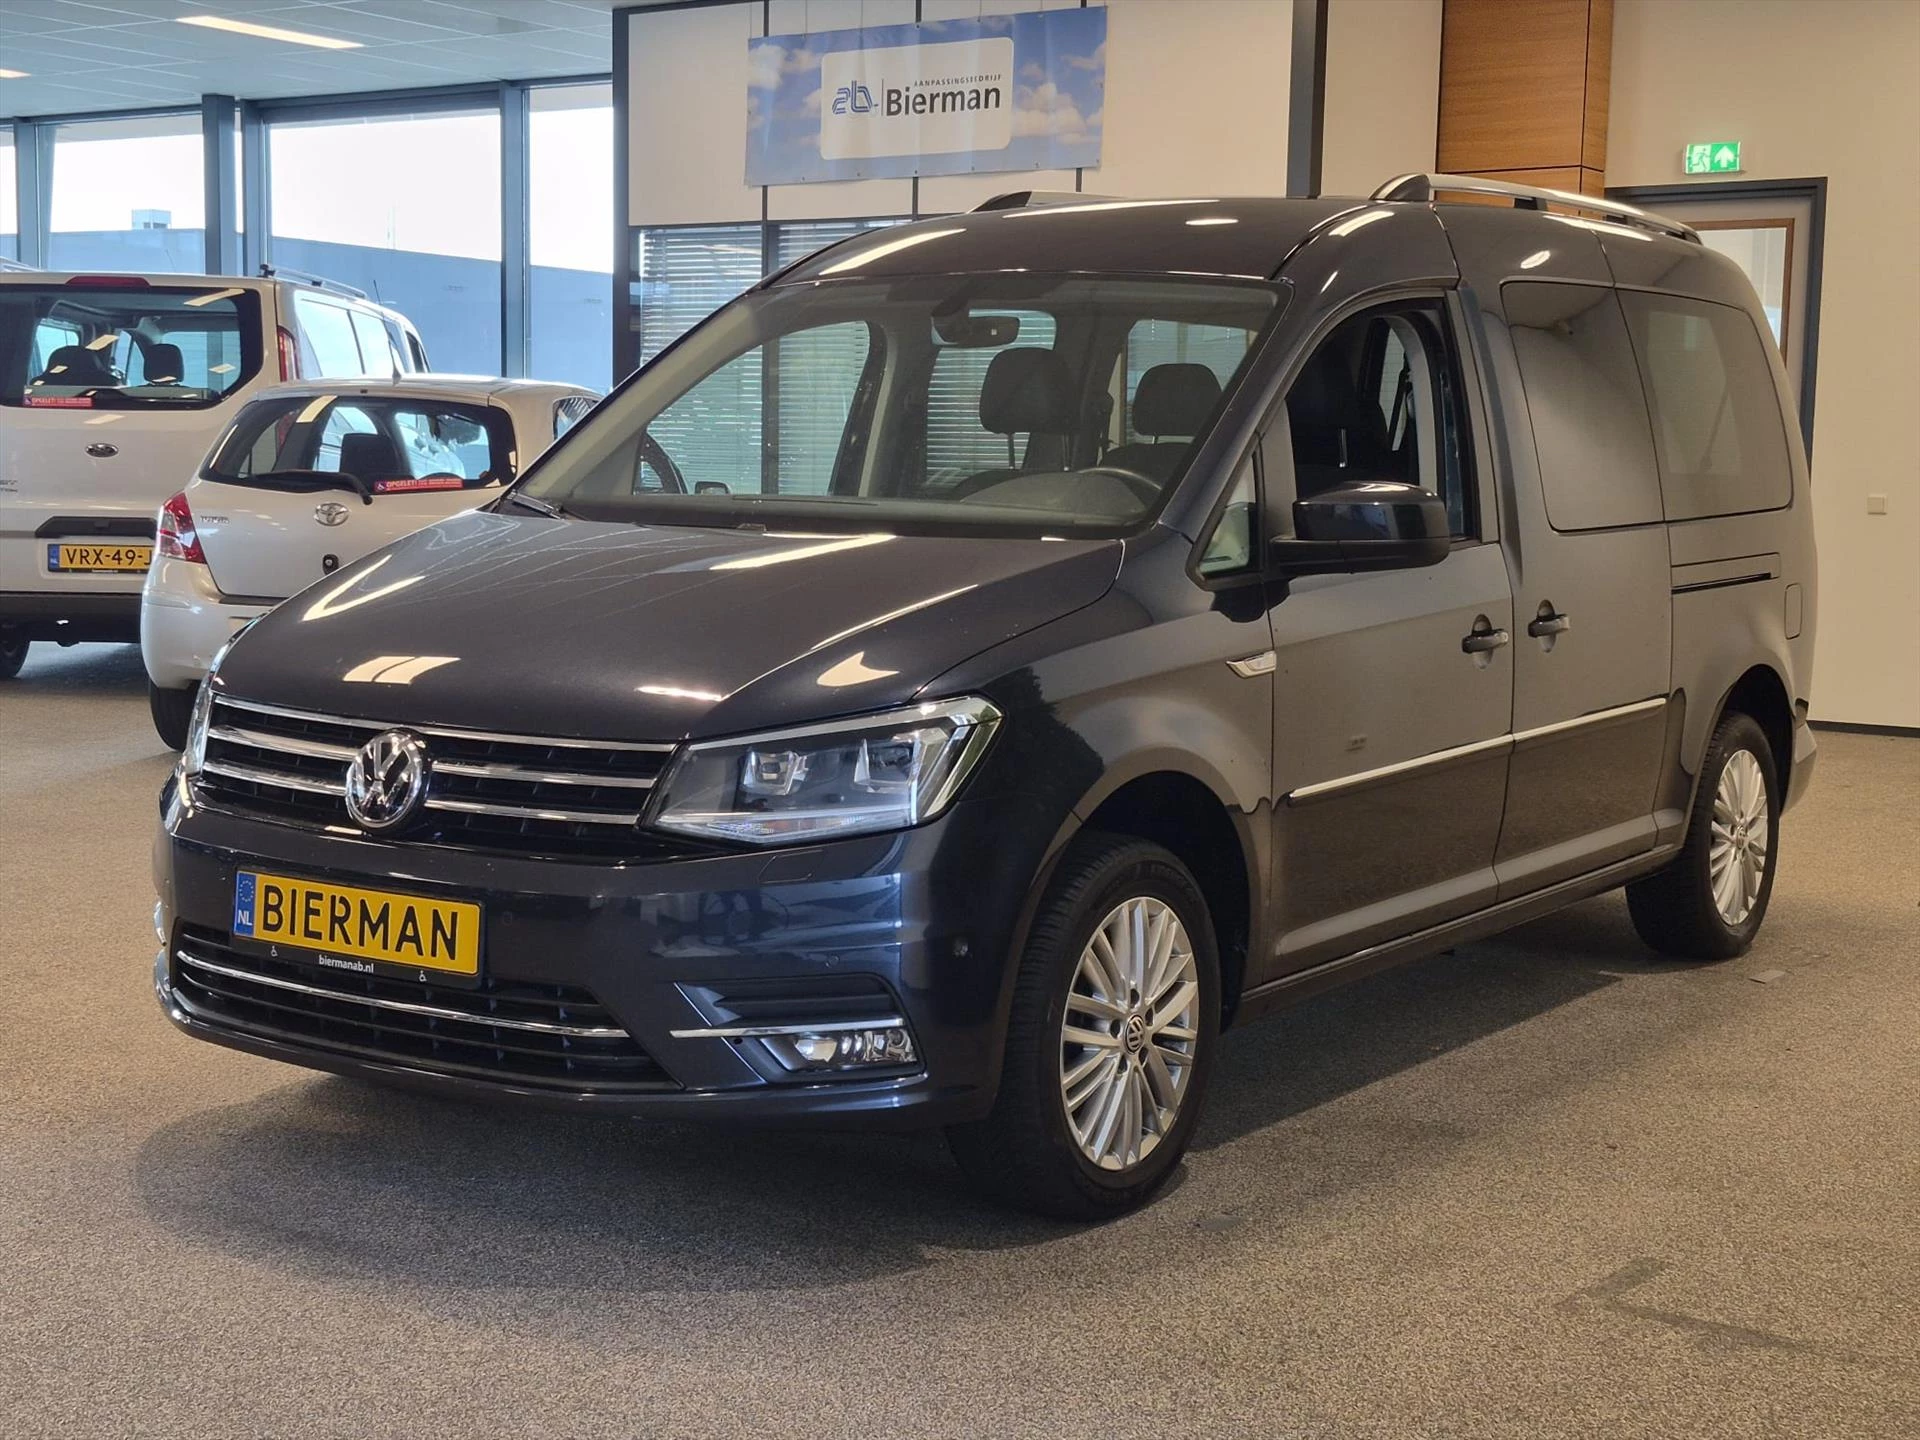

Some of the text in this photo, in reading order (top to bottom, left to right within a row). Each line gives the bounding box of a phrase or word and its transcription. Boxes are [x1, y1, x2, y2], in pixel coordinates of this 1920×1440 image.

[886, 87, 1001, 117] Bierman
[66, 548, 152, 566] VRX-49-J
[237, 909, 253, 926] NL
[263, 884, 459, 961] BIERMAN
[319, 954, 374, 973] biermanab.nl
